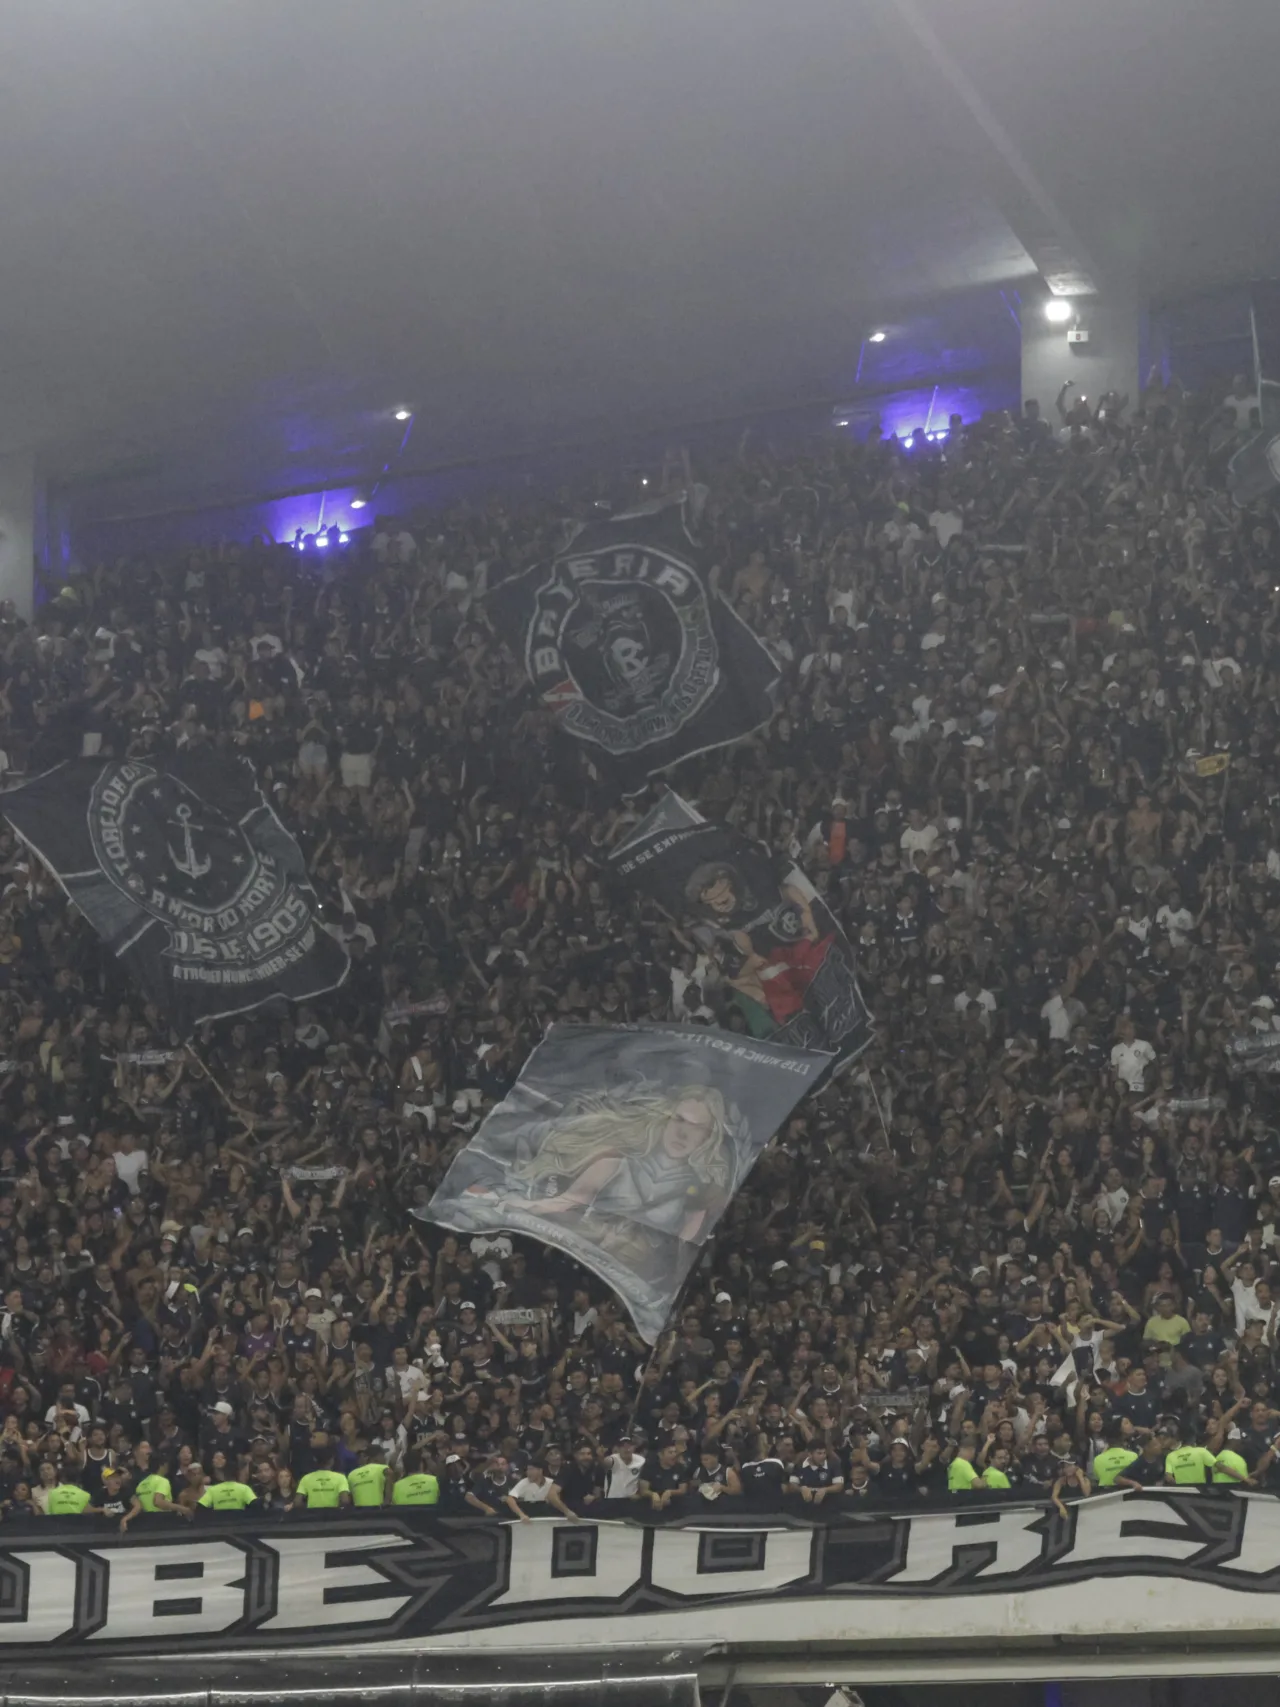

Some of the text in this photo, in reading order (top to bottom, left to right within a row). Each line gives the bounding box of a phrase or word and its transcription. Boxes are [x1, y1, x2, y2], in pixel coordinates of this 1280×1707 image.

[218, 907, 240, 931] DO
[240, 851, 277, 918] NORTE
[246, 894, 308, 952] 1905
[490, 1519, 815, 1606] DO
